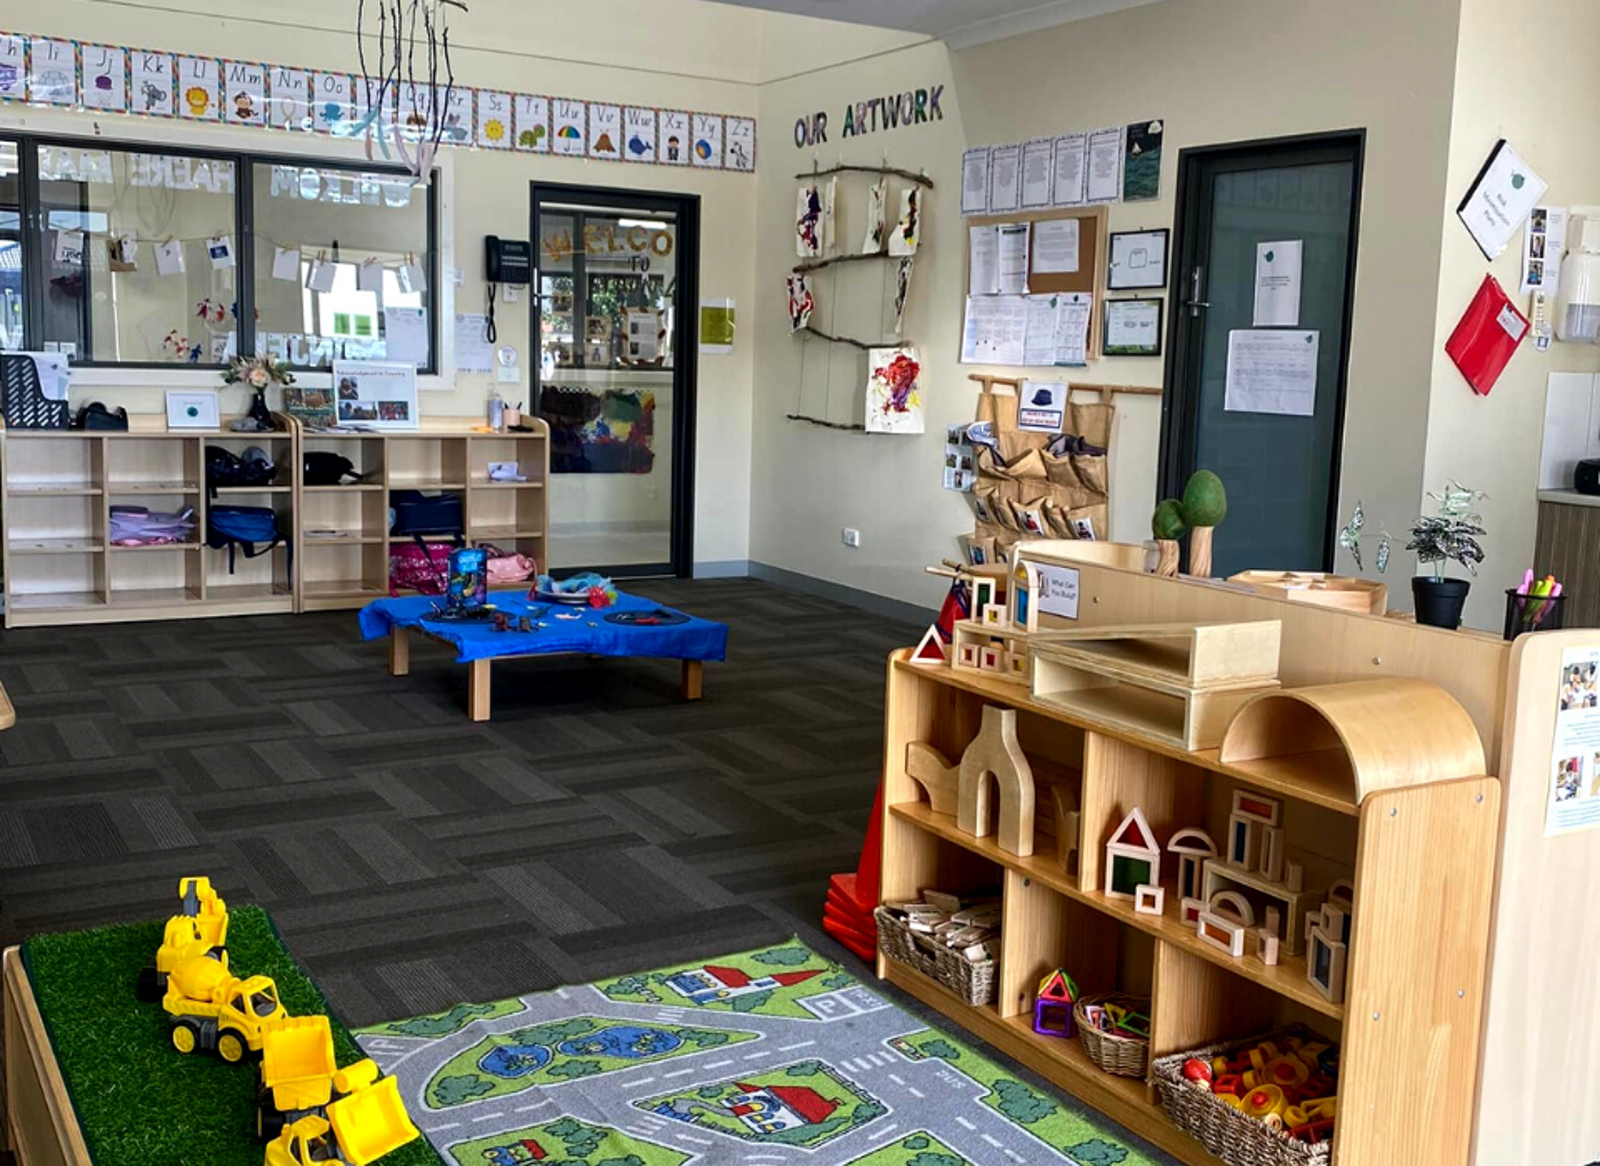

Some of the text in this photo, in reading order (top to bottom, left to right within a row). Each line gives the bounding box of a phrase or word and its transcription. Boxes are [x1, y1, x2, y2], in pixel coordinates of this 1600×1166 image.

[97, 49, 114, 76] Jj
[143, 54, 164, 75] Kk
[229, 65, 262, 84] Mm
[278, 71, 302, 89] Nn
[323, 76, 343, 94] Oo
[488, 94, 503, 112] Ss
[525, 97, 540, 116] Tt
[559, 102, 579, 119] Uu
[596, 107, 615, 123] Vv
[627, 110, 653, 126] Ww
[664, 114, 683, 131] Xx
[794, 84, 945, 149] OUR ARTWORK
[699, 116, 716, 138] Yy
[730, 121, 750, 138] Zz
[541, 224, 673, 263] WELCO
[814, 1000, 835, 1014] P
